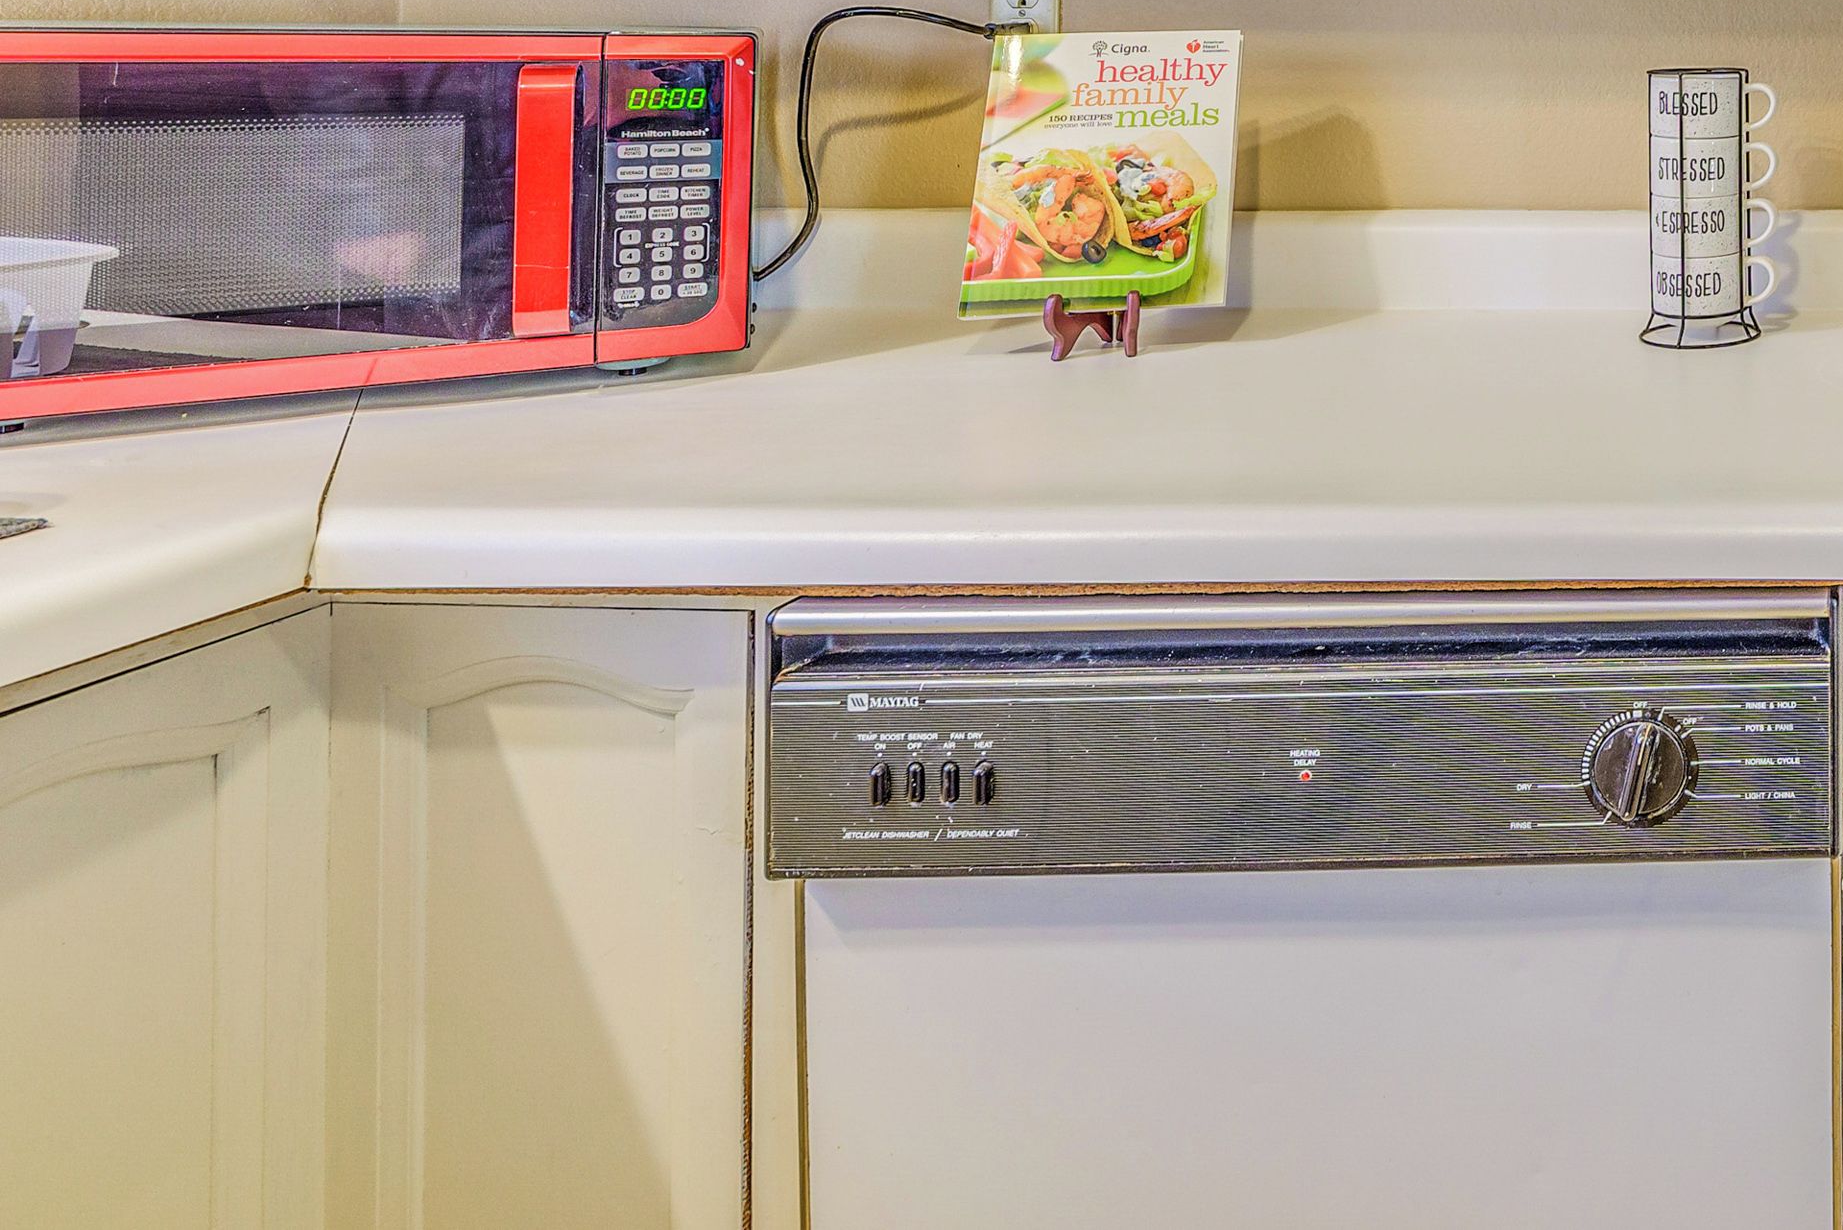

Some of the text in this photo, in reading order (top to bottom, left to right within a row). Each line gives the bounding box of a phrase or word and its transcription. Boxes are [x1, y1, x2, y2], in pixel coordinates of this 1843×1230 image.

[1111, 43, 1148, 56] Cigna
[1095, 58, 1228, 86] healthy
[628, 88, 706, 109] 00:00
[1071, 80, 1188, 110] family
[1659, 90, 1718, 116] BLESSED
[1115, 103, 1219, 128] meals
[621, 129, 706, 138] Hamilton Beach
[1658, 157, 1725, 182] STRESSED
[1656, 271, 1721, 298] OBSESSED
[870, 696, 919, 708] MAYTAG
[1777, 701, 1797, 709] HOLD
[880, 733, 906, 741] BOOST
[908, 733, 938, 741] SENSOR
[907, 742, 922, 750] OFF
[974, 741, 994, 749] HEAT
[1290, 749, 1320, 757] HEATING
[1777, 757, 1801, 765] CYCLE
[1516, 783, 1532, 791] DRY
[1773, 791, 1796, 799] CHINA
[843, 831, 880, 839] JETCLEAN
[881, 830, 930, 839] DISHWASHER
[946, 830, 994, 839] DEPENDABLY
[996, 829, 1020, 838] QUIET
